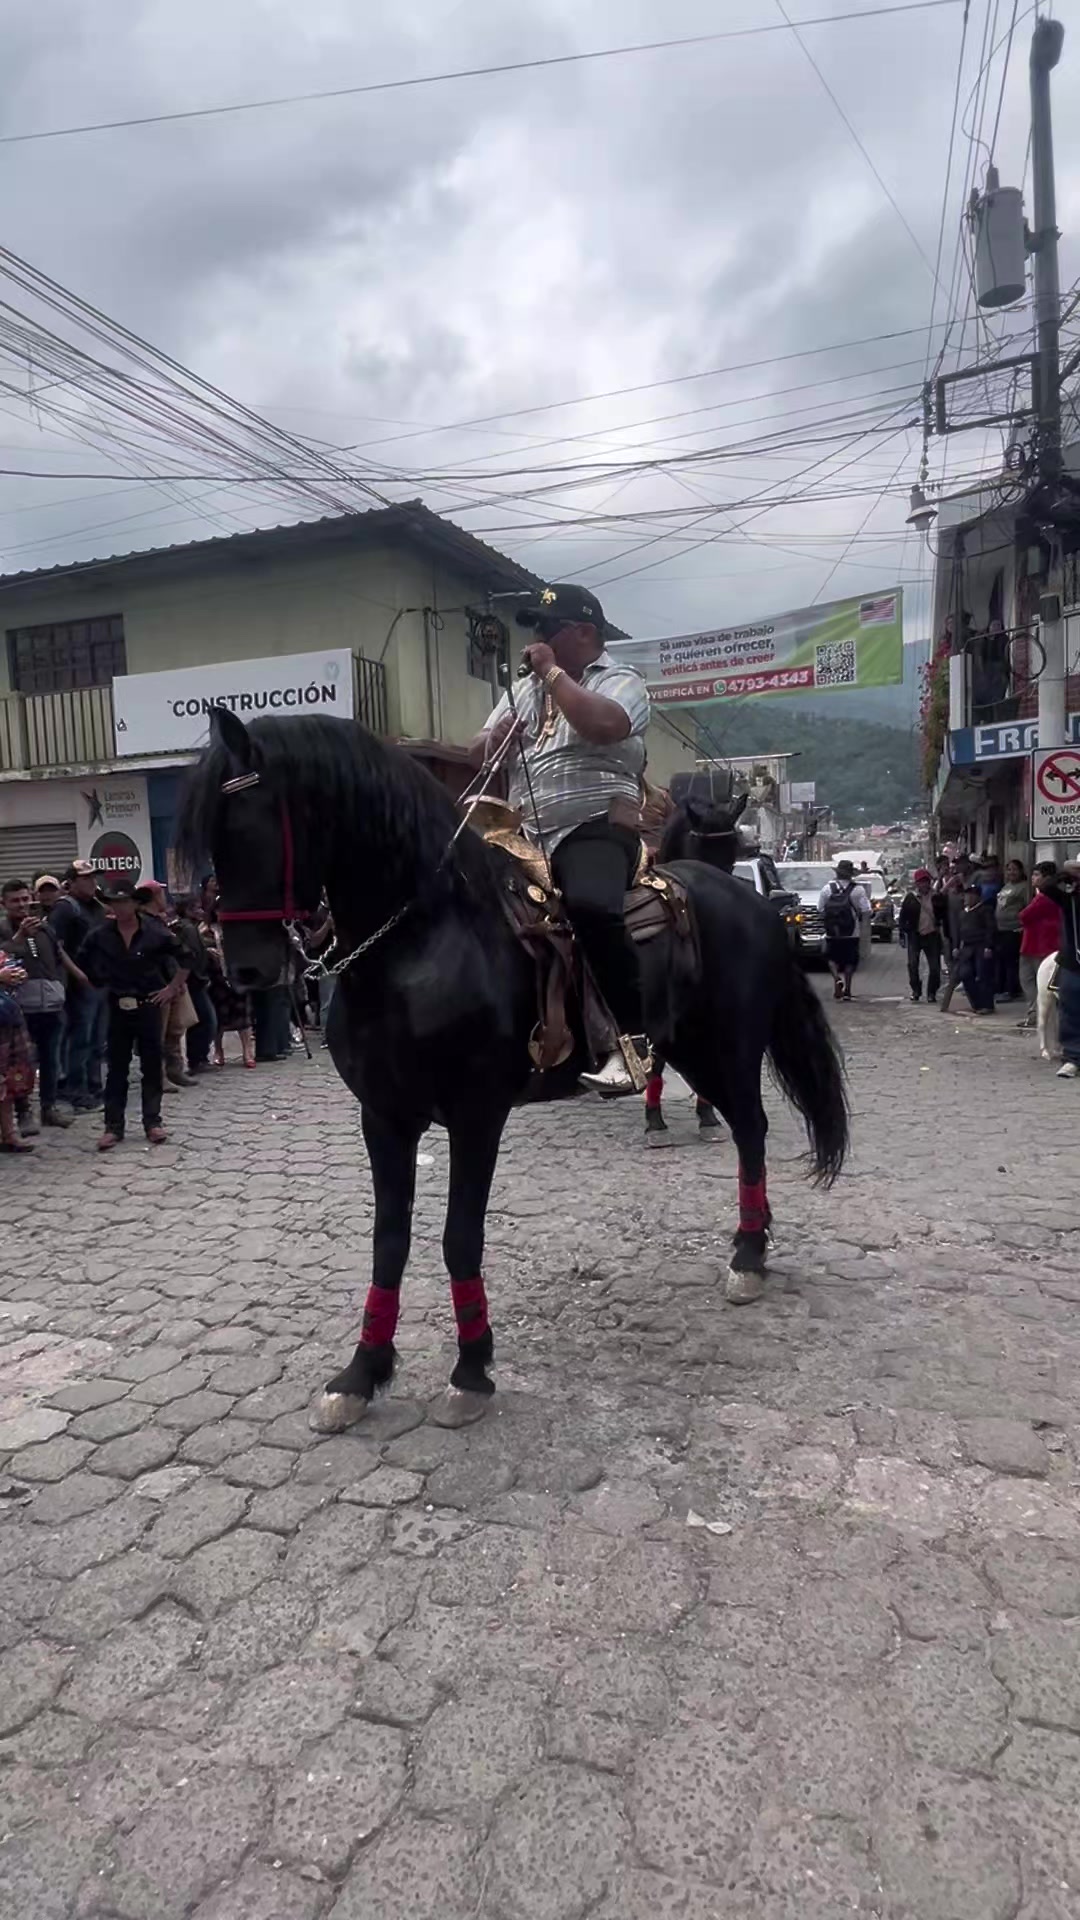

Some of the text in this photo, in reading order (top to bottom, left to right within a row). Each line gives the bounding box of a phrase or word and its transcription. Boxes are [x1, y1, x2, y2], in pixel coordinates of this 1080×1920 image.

[660, 625, 775, 651] Si una visa de trabajo
[660, 639, 775, 663] te quieren ofrecer,
[661, 653, 775, 676] verificá antes de creer
[697, 685, 710, 695] EN
[727, 670, 809, 692] 4793-4343
[173, 681, 337, 717] CONSTRUCCIÓN
[1041, 806, 1055, 815] NO
[1048, 815, 1080, 825] AMBOS
[1049, 826, 1080, 836] LADOS
[91, 856, 141, 870] TOLTECA
